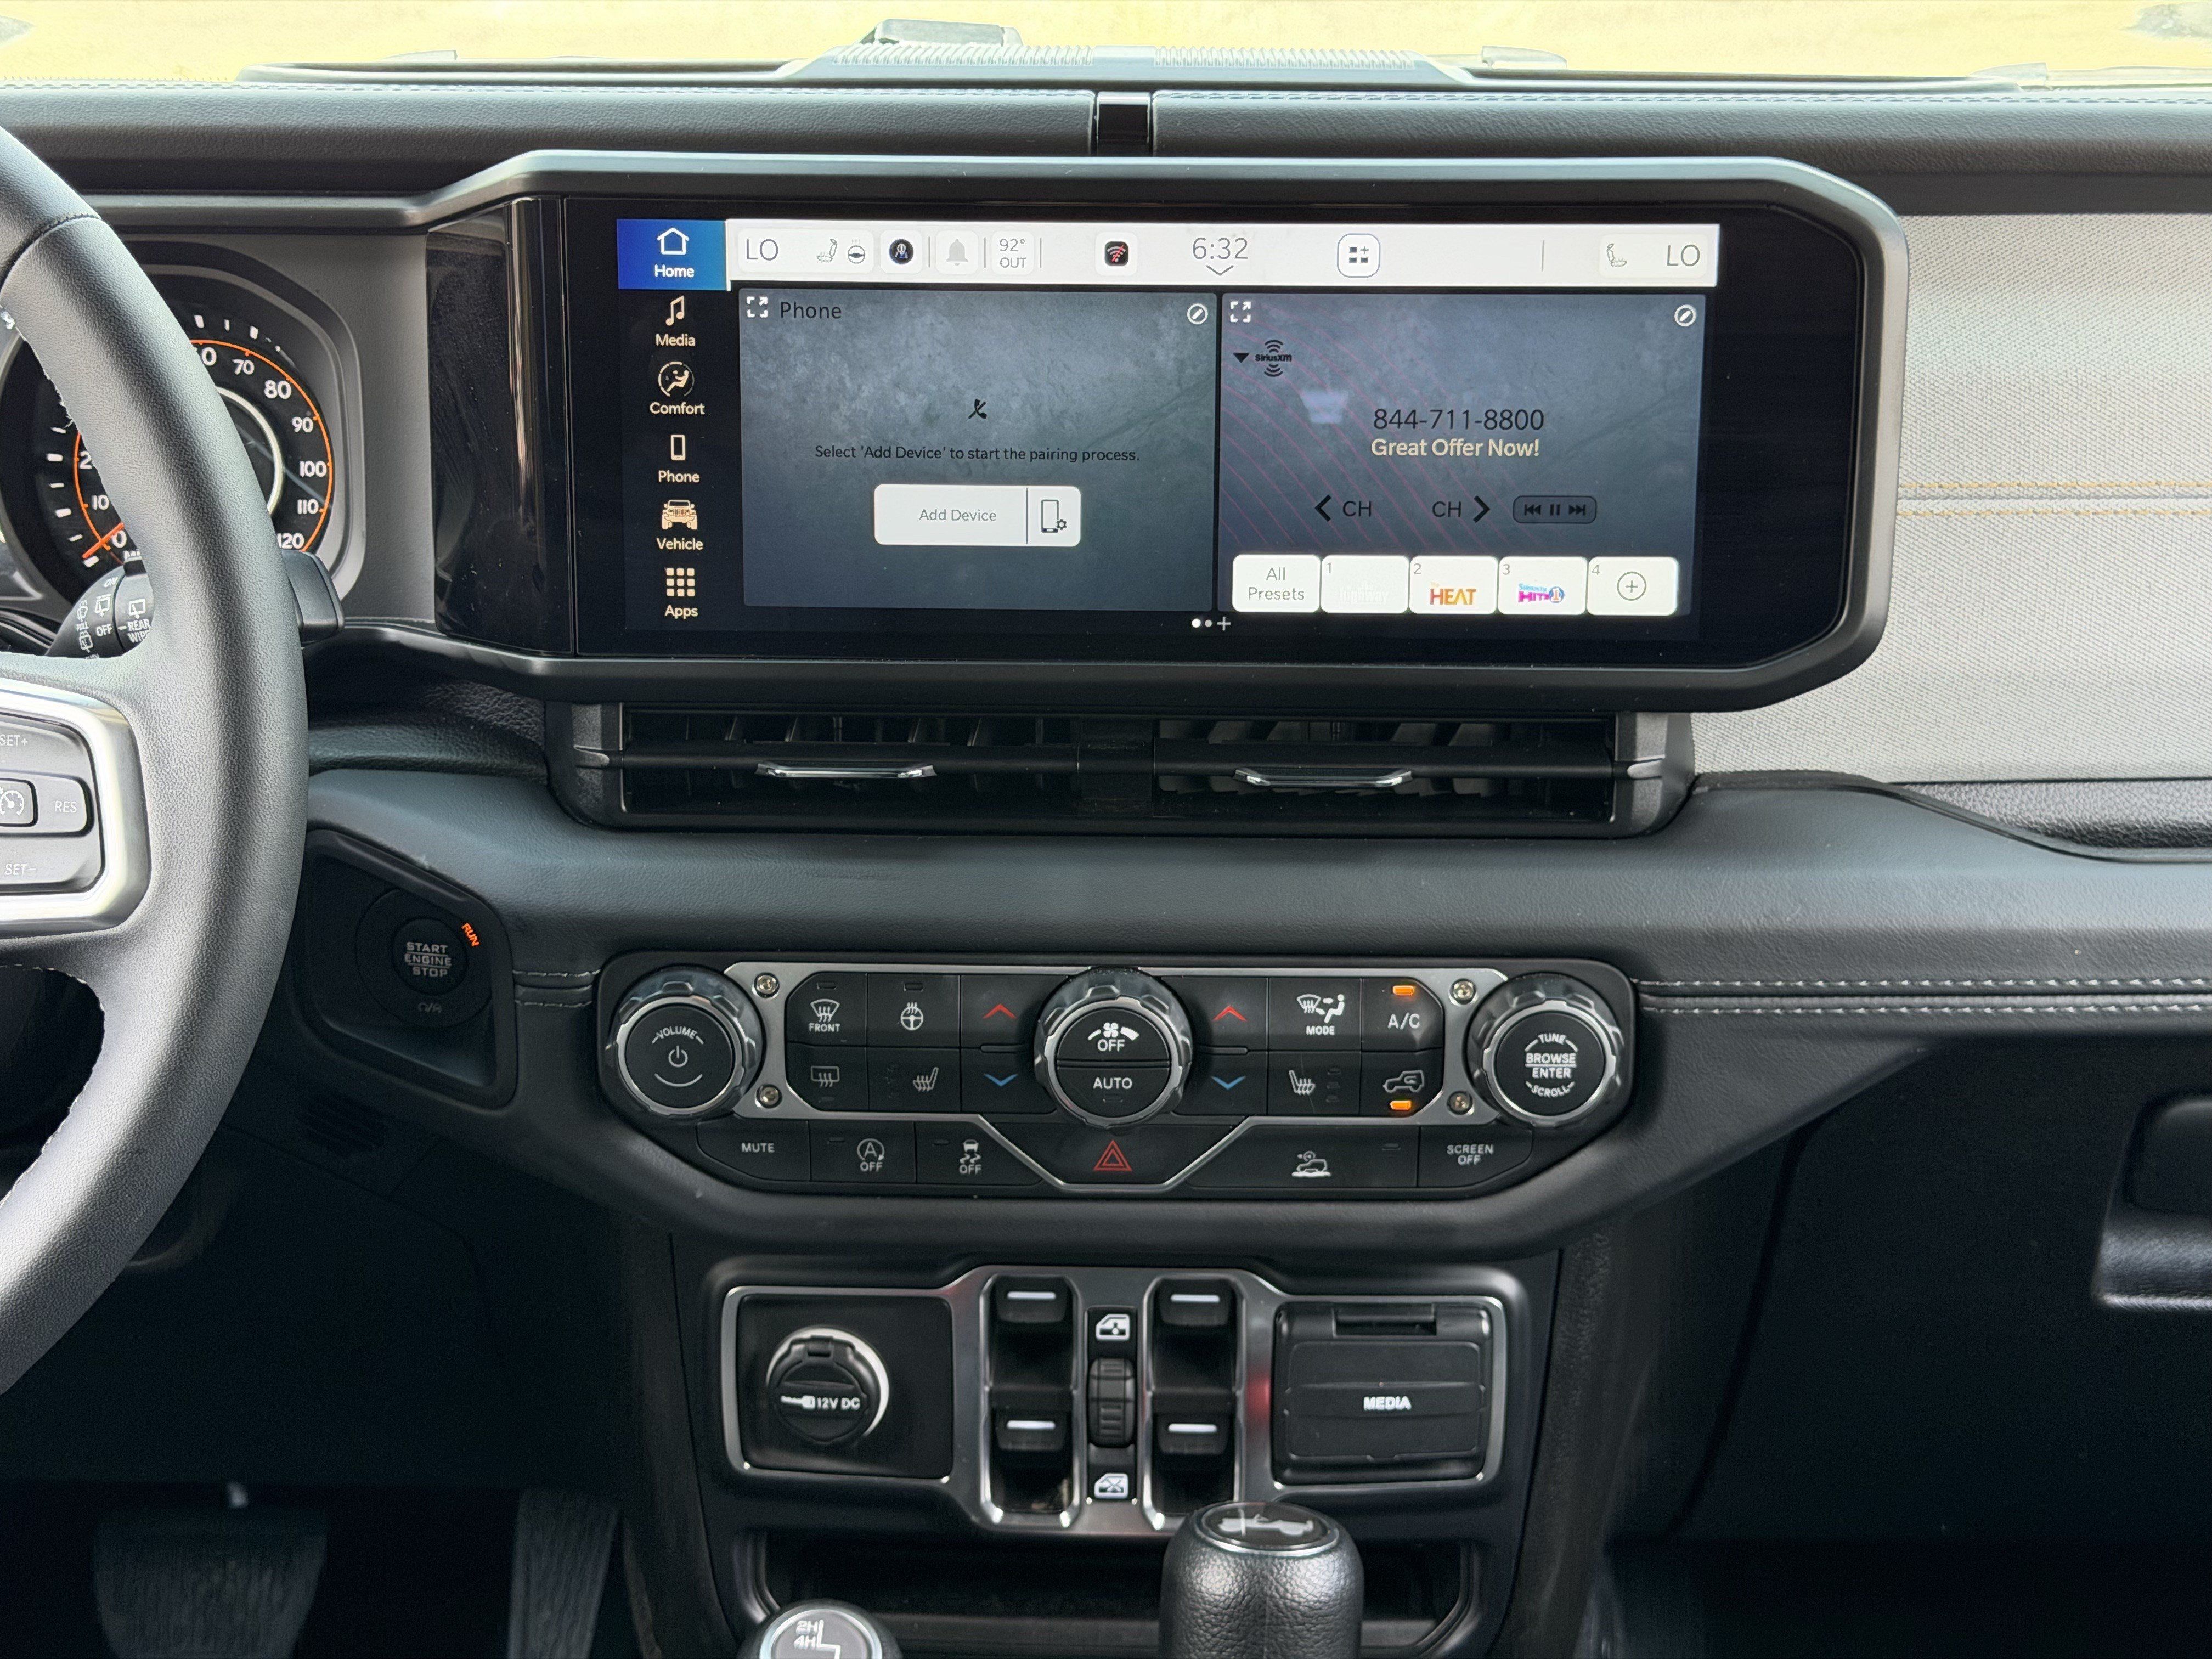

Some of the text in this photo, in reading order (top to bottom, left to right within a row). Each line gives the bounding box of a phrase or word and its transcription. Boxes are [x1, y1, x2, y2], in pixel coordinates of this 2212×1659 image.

[745, 238, 779, 261] LO
[999, 238, 1026, 252] 92°
[1192, 237, 1249, 259] 6:32
[1666, 244, 1701, 266] LO
[1000, 257, 1027, 268] OUT
[654, 264, 695, 278] Home
[780, 302, 842, 320] Phone
[656, 334, 696, 347] Media
[1255, 353, 1293, 363] SiriusXM
[233, 358, 255, 375] 70
[264, 380, 292, 400] 80
[650, 402, 706, 415] Comfort
[291, 416, 314, 433] 90
[1374, 409, 1544, 430] 844-711-8800
[815, 445, 1141, 464] Select 'Add Device' to start the pairing process.
[1371, 439, 1541, 458] Great Offer Now!
[299, 460, 327, 478] 100
[658, 470, 700, 483] Phone
[92, 495, 109, 510] 10
[297, 499, 319, 515] 110
[1342, 500, 1373, 517] CH
[1432, 501, 1462, 518] CH
[919, 509, 997, 522] Add Device
[111, 531, 127, 548] 0
[276, 533, 304, 549] 120
[656, 537, 704, 551] Vehicle
[1266, 567, 1286, 582] All
[1327, 562, 1332, 574] 1
[1413, 562, 1423, 575] 2
[1502, 563, 1511, 575] 3
[1591, 564, 1601, 577] 4
[104, 577, 119, 588] ON
[1248, 586, 1305, 601] Presets
[1430, 588, 1477, 606] HEAT
[664, 605, 699, 619] Apps
[95, 623, 112, 637] OFF
[127, 618, 151, 632] REAR
[55, 800, 77, 813] RES
[461, 922, 481, 947] RUN
[406, 941, 448, 954] START
[404, 953, 452, 966] ENGINE
[413, 966, 448, 978] STOP
[809, 1023, 841, 1032] FRONT
[1387, 1012, 1421, 1030] A/C
[656, 1025, 698, 1040] VOLUME
[1306, 1025, 1335, 1036] MODE
[1097, 1039, 1125, 1052] OFF
[1538, 1032, 1567, 1045] TUNE
[1525, 1052, 1577, 1064] BROWSE
[1532, 1067, 1572, 1079] ENTER
[1092, 1077, 1133, 1090] AUTO
[1531, 1085, 1571, 1098] SCROLL
[741, 1142, 775, 1153] MUTE
[1447, 1144, 1494, 1155] SCREEN
[860, 1161, 883, 1172] OFF
[1457, 1155, 1482, 1165] OFF
[959, 1164, 982, 1175] OFF
[816, 1397, 861, 1410] 12V DC
[1363, 1396, 1412, 1412] MEDIA
[796, 1620, 819, 1634] 2H
[793, 1634, 817, 1648] 4H
